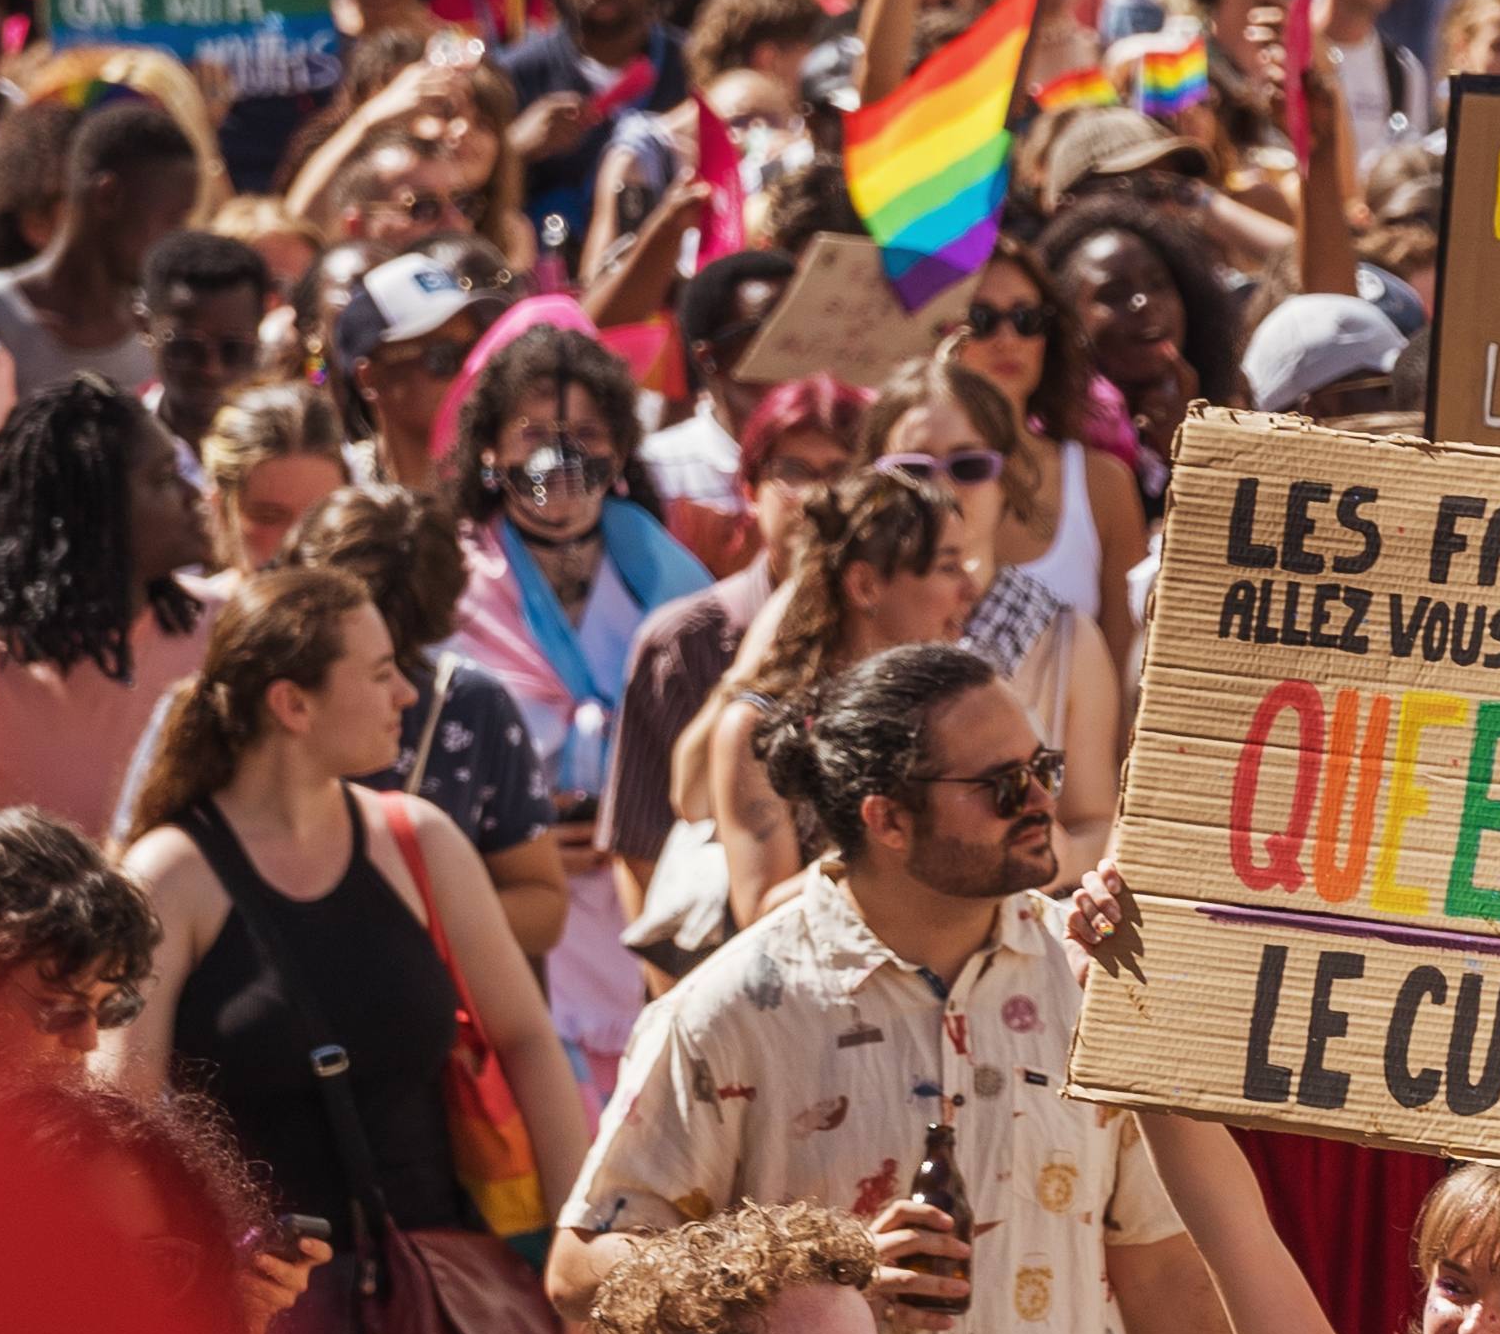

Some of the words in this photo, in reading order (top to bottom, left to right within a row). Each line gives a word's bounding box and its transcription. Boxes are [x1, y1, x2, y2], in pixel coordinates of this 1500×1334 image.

[1227, 477, 1382, 574] LES
[1218, 578, 1375, 656] ALLEZ
[1242, 945, 1366, 1110] LE
